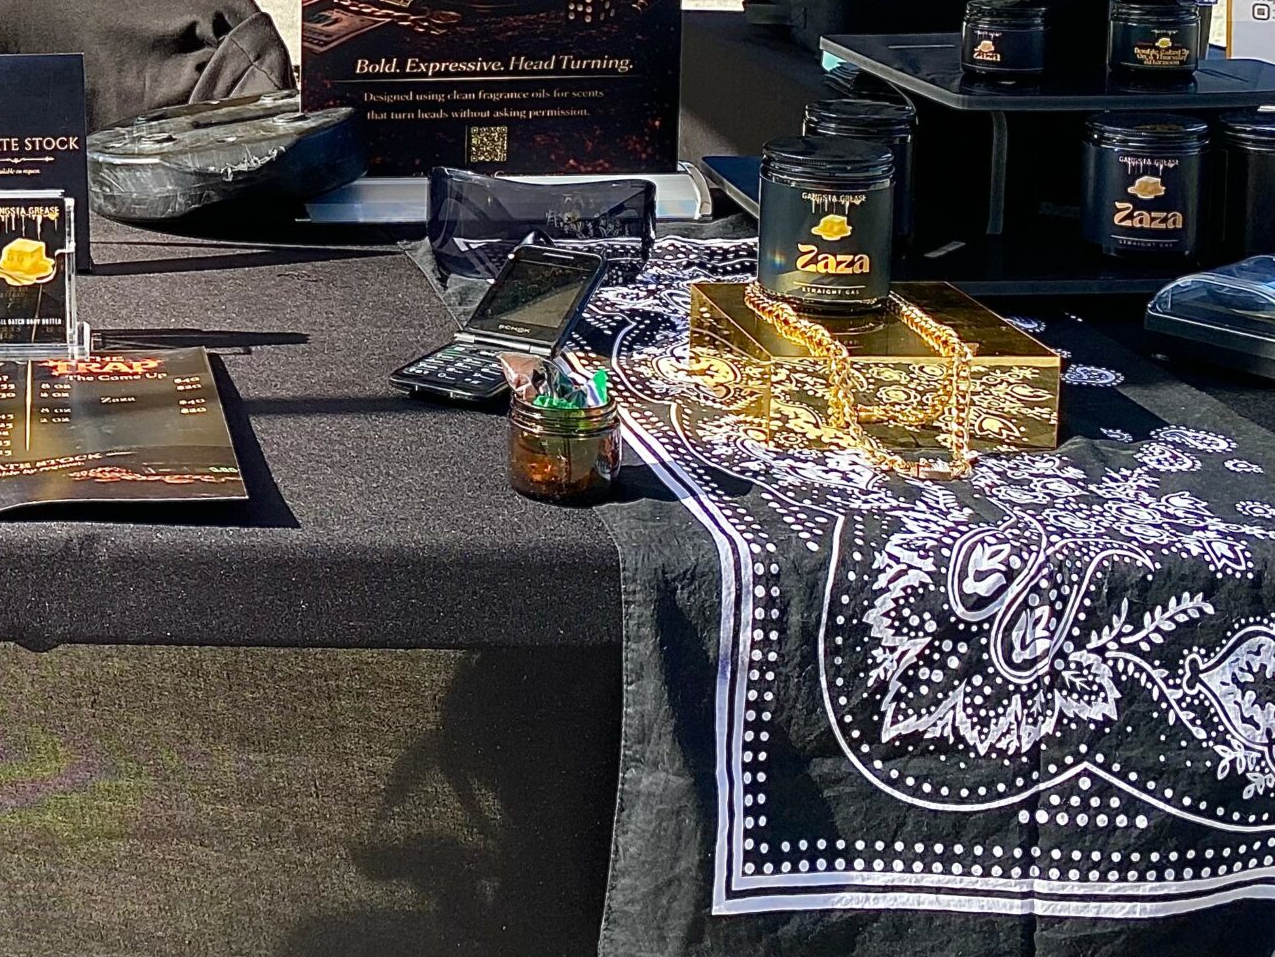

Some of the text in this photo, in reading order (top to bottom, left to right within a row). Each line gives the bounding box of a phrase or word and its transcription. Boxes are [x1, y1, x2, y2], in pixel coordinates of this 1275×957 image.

[355, 55, 634, 76] Bold. Expressive. Head Turning.
[364, 88, 605, 103] Designed using clean fragrance oils for scents
[367, 107, 590, 120] that turn heads without asking permission.
[24, 136, 79, 151] STOCK
[801, 192, 838, 203] GANGSTA
[28, 206, 60, 218] GREASE
[1113, 201, 1183, 229] Zaza
[796, 243, 870, 274] Zaza
[802, 287, 842, 295] STRAIGHT
[50, 359, 160, 376] TRAP
[97, 373, 141, 382] Come
[145, 371, 168, 380] Up
[35, 452, 103, 468] STOCK
